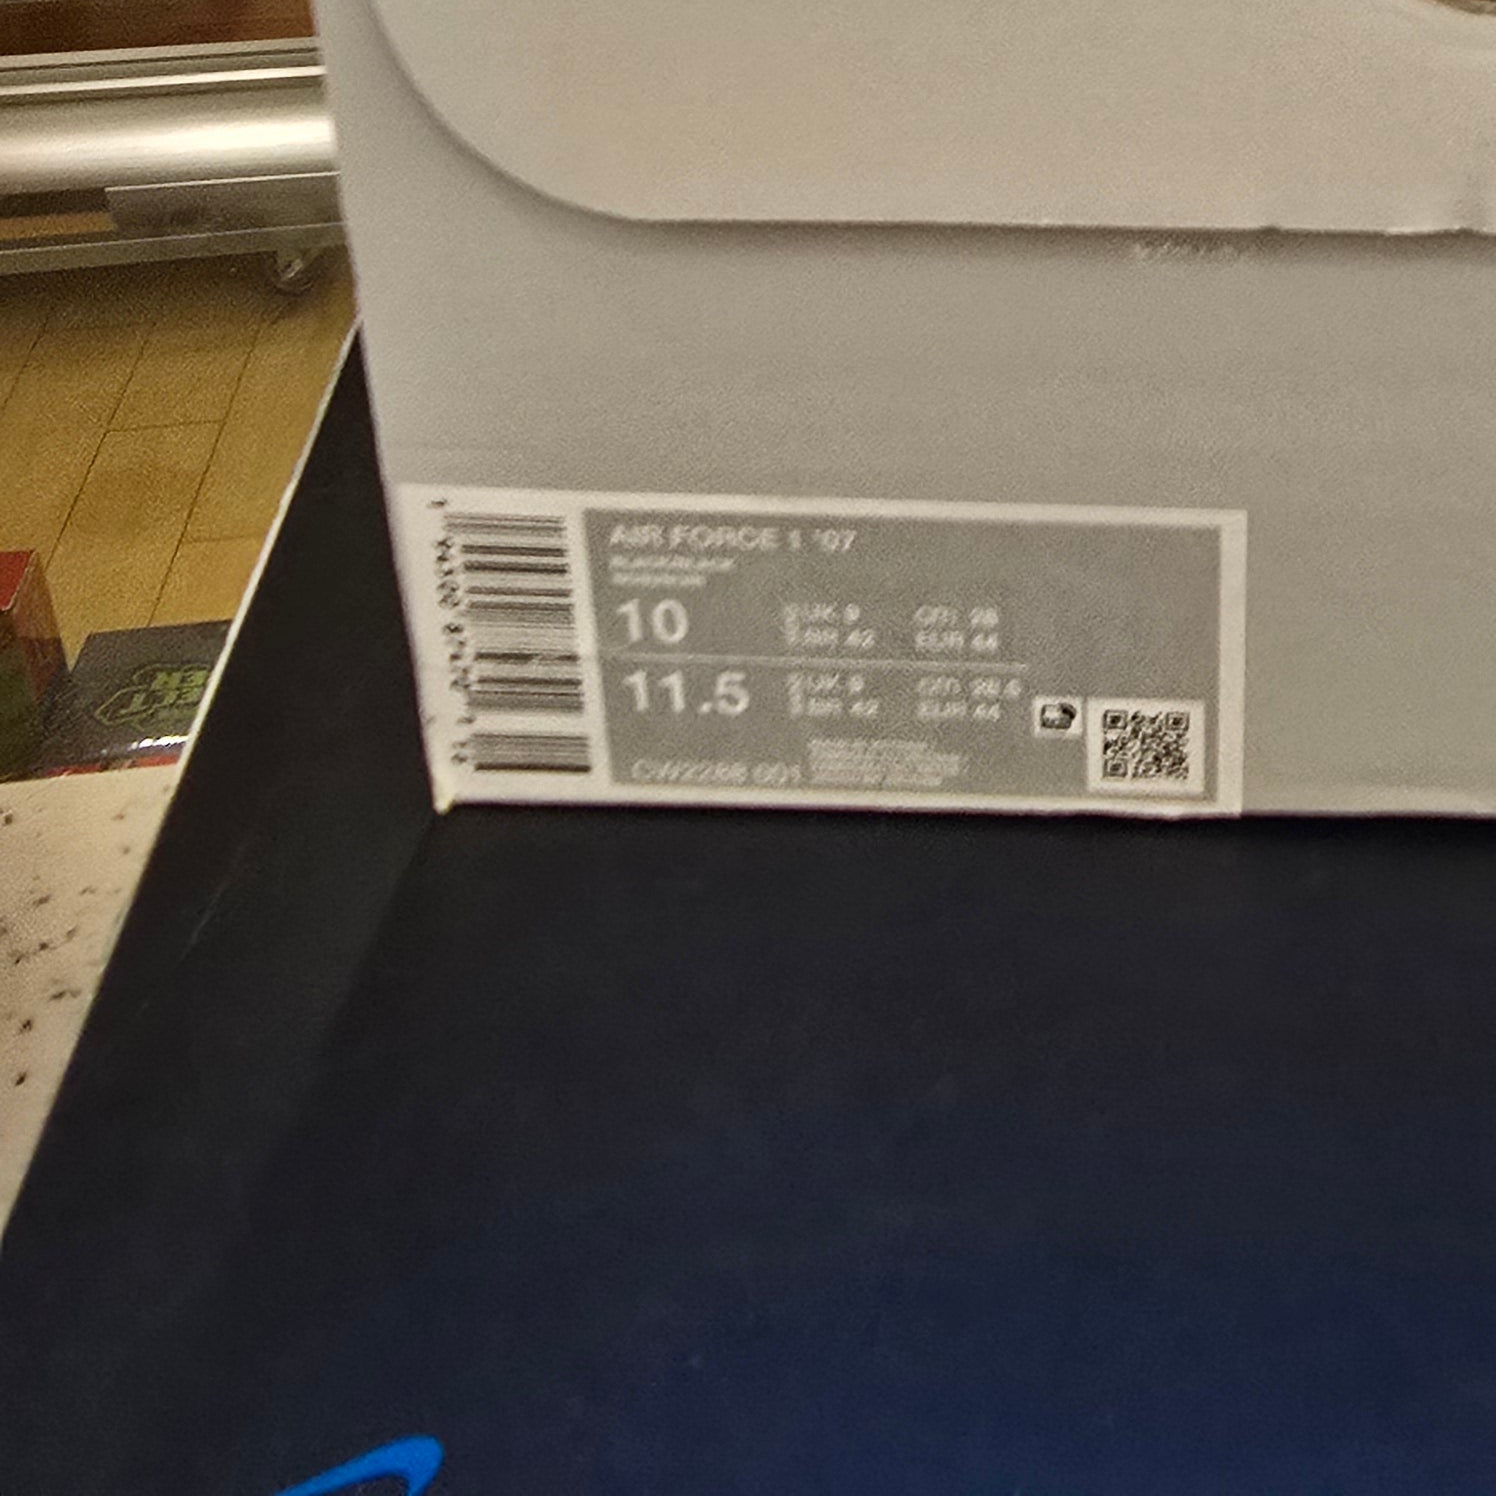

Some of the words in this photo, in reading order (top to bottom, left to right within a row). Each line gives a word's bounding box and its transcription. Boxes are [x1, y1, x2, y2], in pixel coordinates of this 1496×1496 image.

[669, 525, 779, 550] FORCE
[616, 598, 690, 644] 10
[622, 670, 751, 717] 11.5
